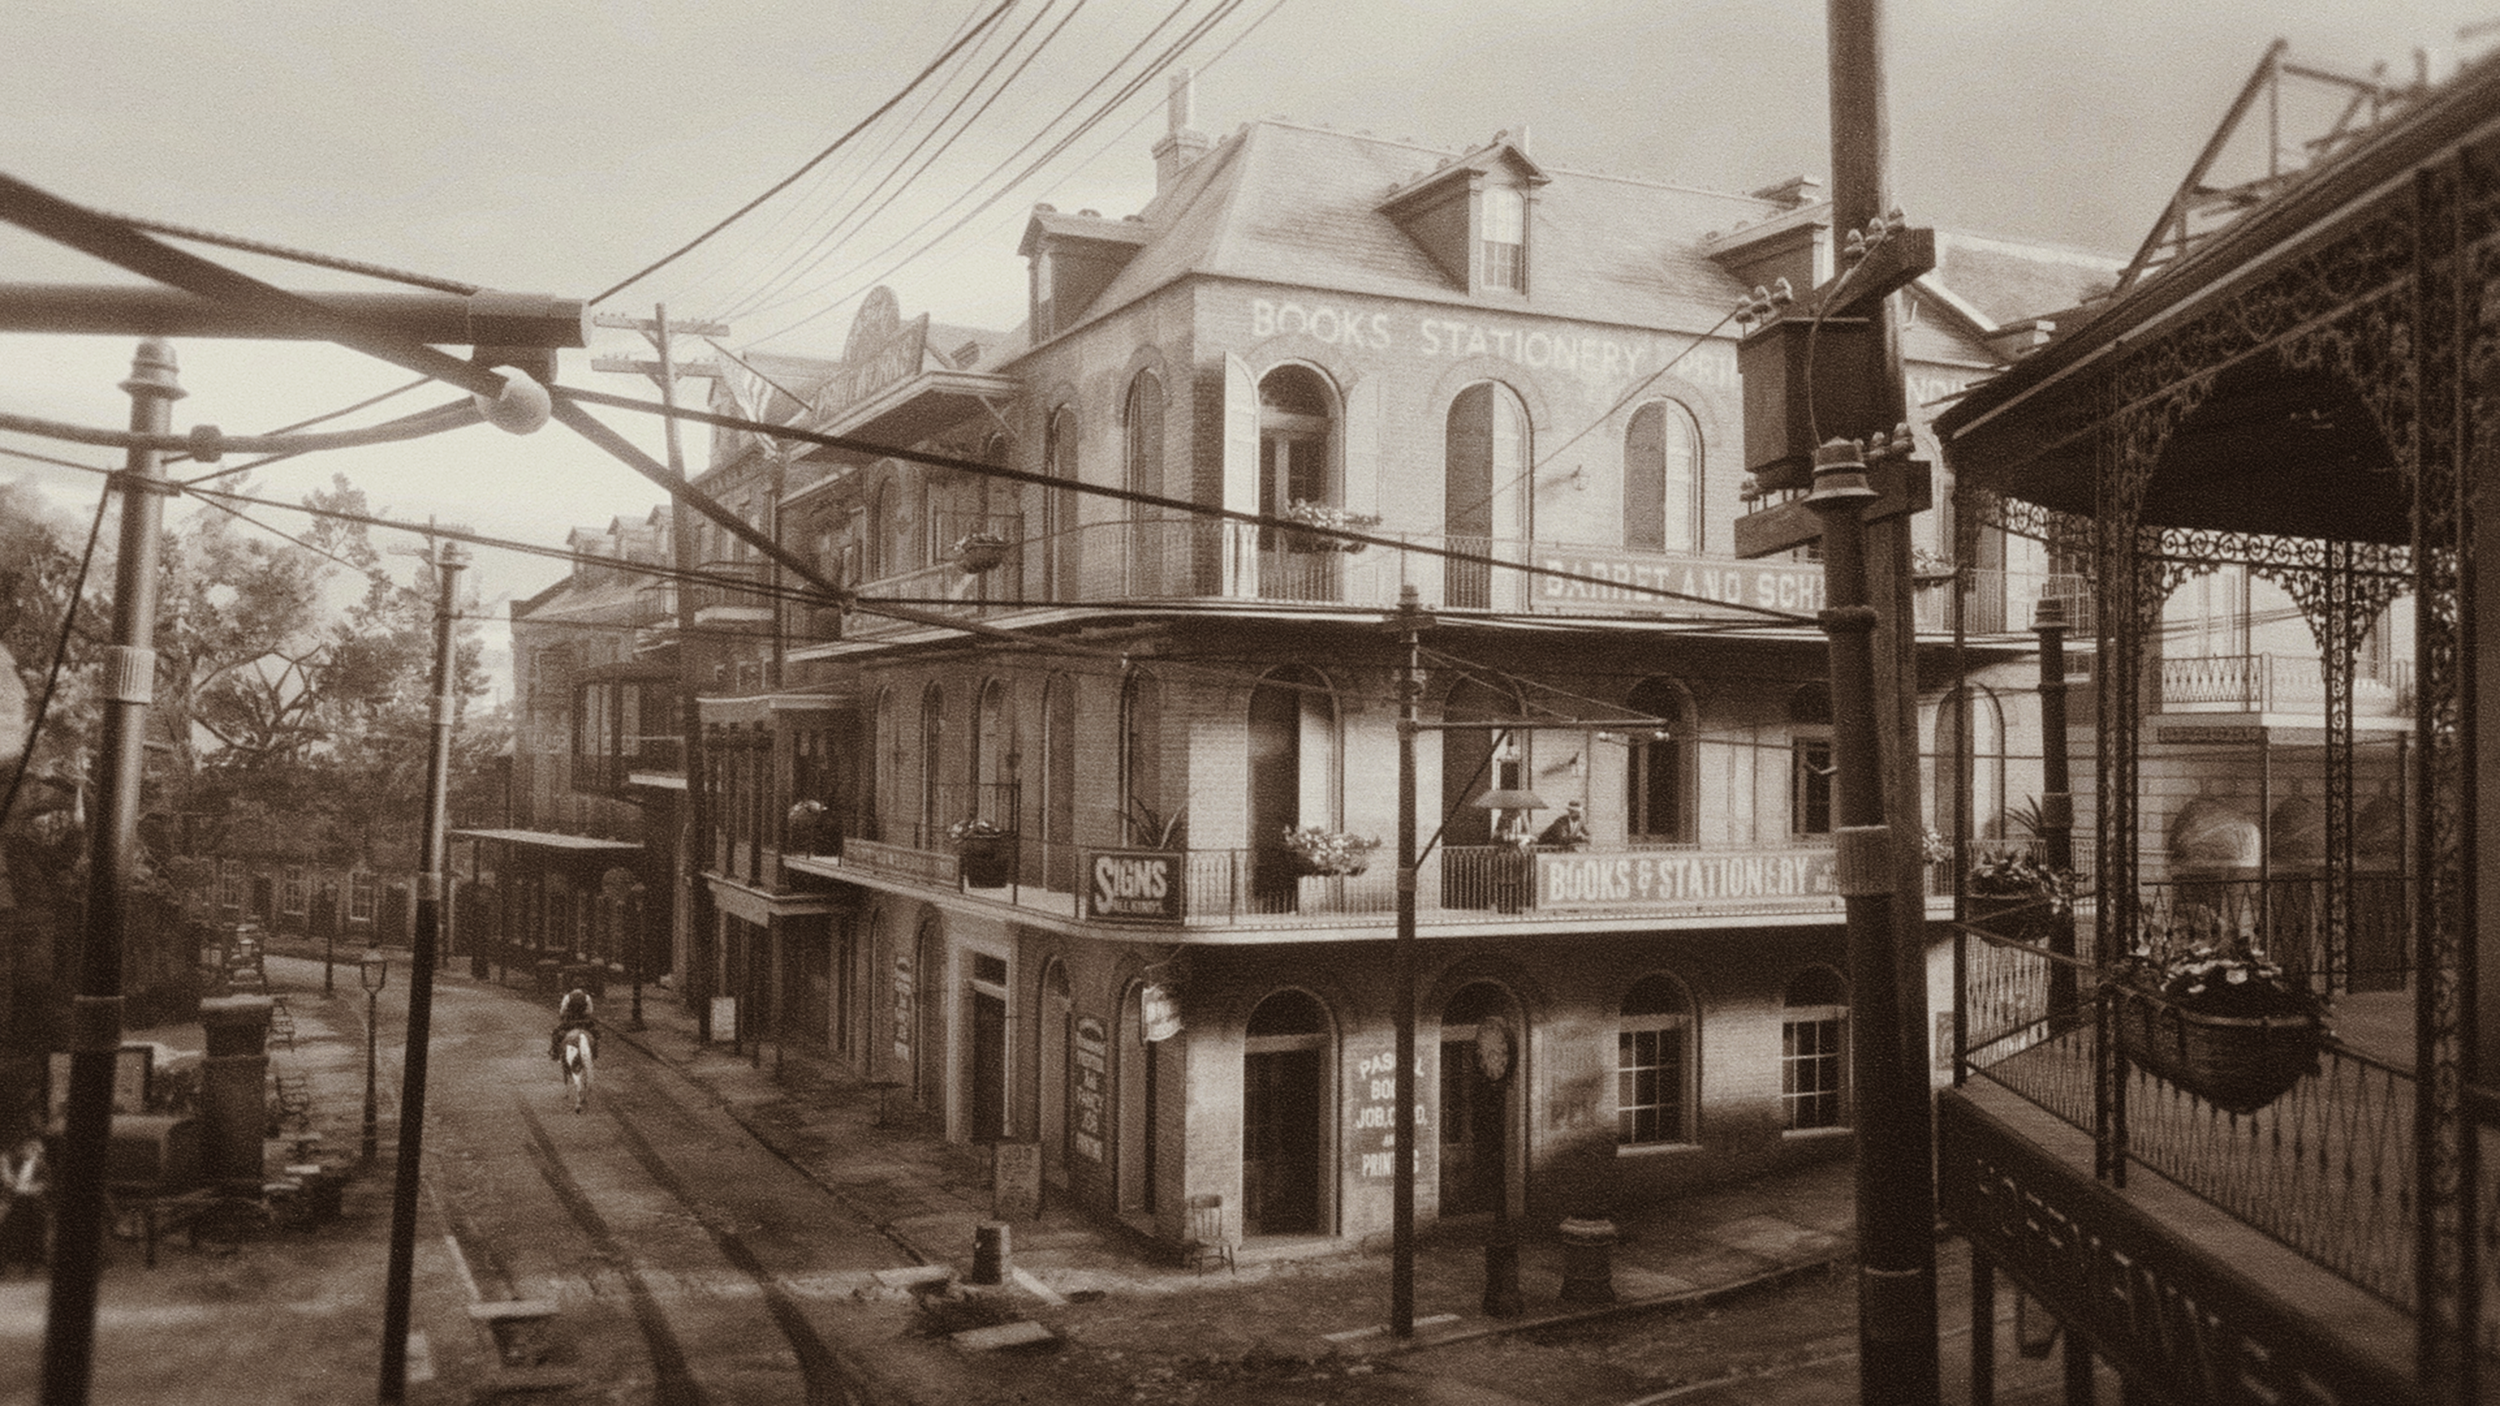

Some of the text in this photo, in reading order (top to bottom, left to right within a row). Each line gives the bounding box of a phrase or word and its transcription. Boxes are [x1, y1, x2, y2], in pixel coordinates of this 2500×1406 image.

[1253, 300, 1392, 350] BOOKS
[1420, 317, 1641, 376] STATIONERY
[1094, 856, 1167, 914] SIGNS
[1549, 857, 1631, 901] BOOKS
[1657, 855, 1810, 898] STATIONERY
